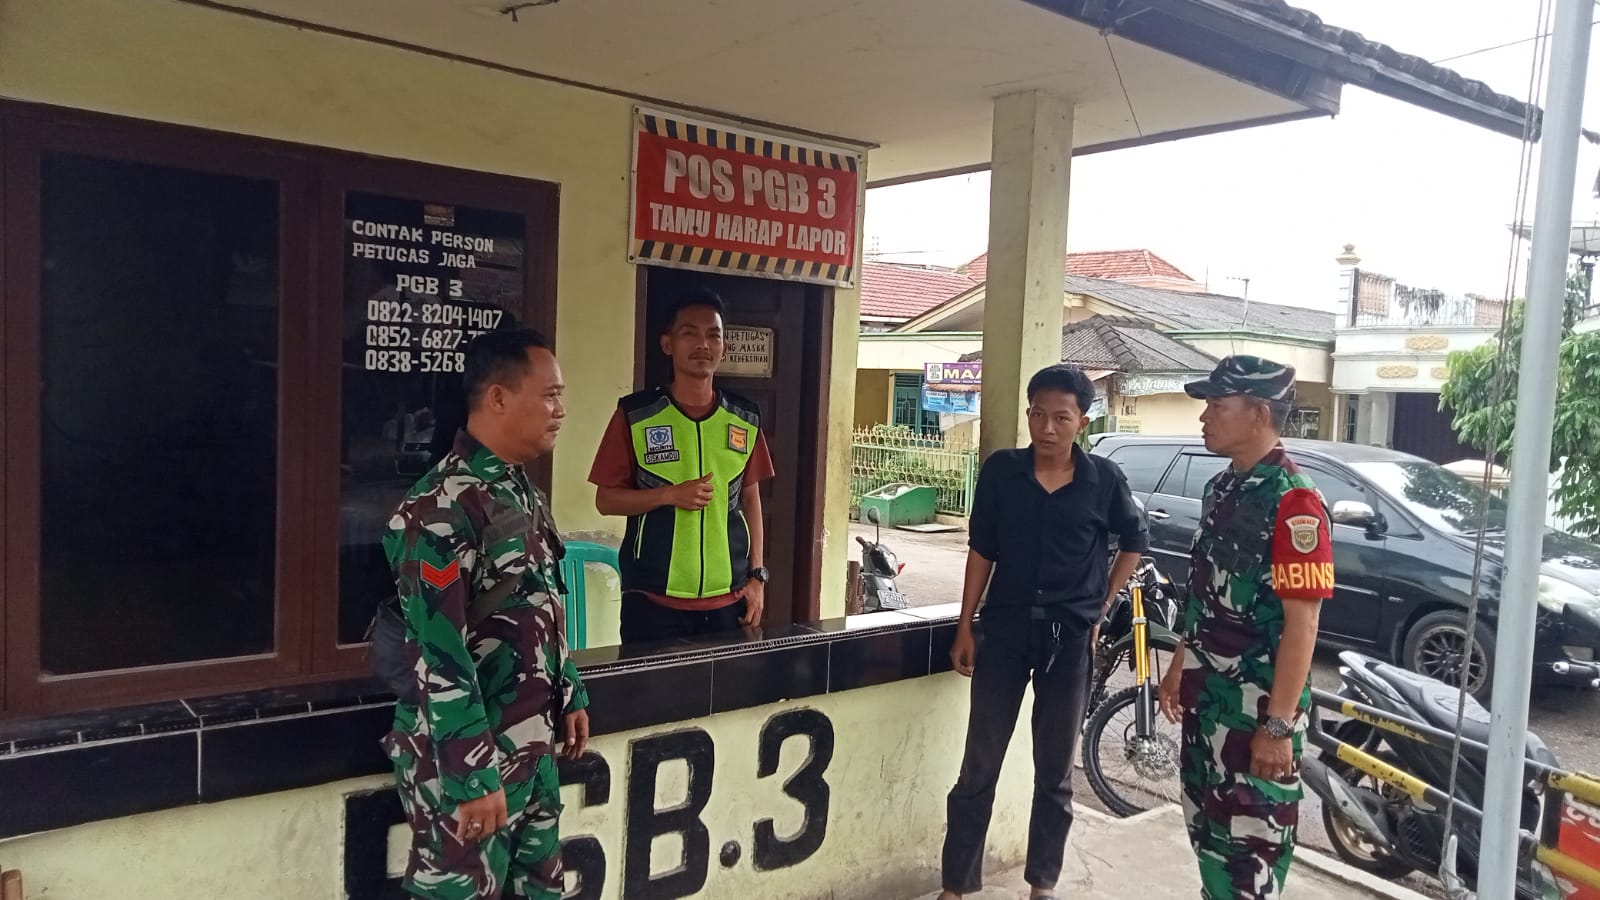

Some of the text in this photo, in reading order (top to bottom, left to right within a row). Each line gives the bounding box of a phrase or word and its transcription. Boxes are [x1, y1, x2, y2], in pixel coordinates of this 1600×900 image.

[663, 148, 836, 219] POS PGB 3
[352, 219, 494, 253] CONTAK PERSON
[649, 202, 846, 256] TAMU HARAP LAPOR
[351, 242, 476, 269] PETUGAS JAGA
[395, 274, 463, 297] PGB 3
